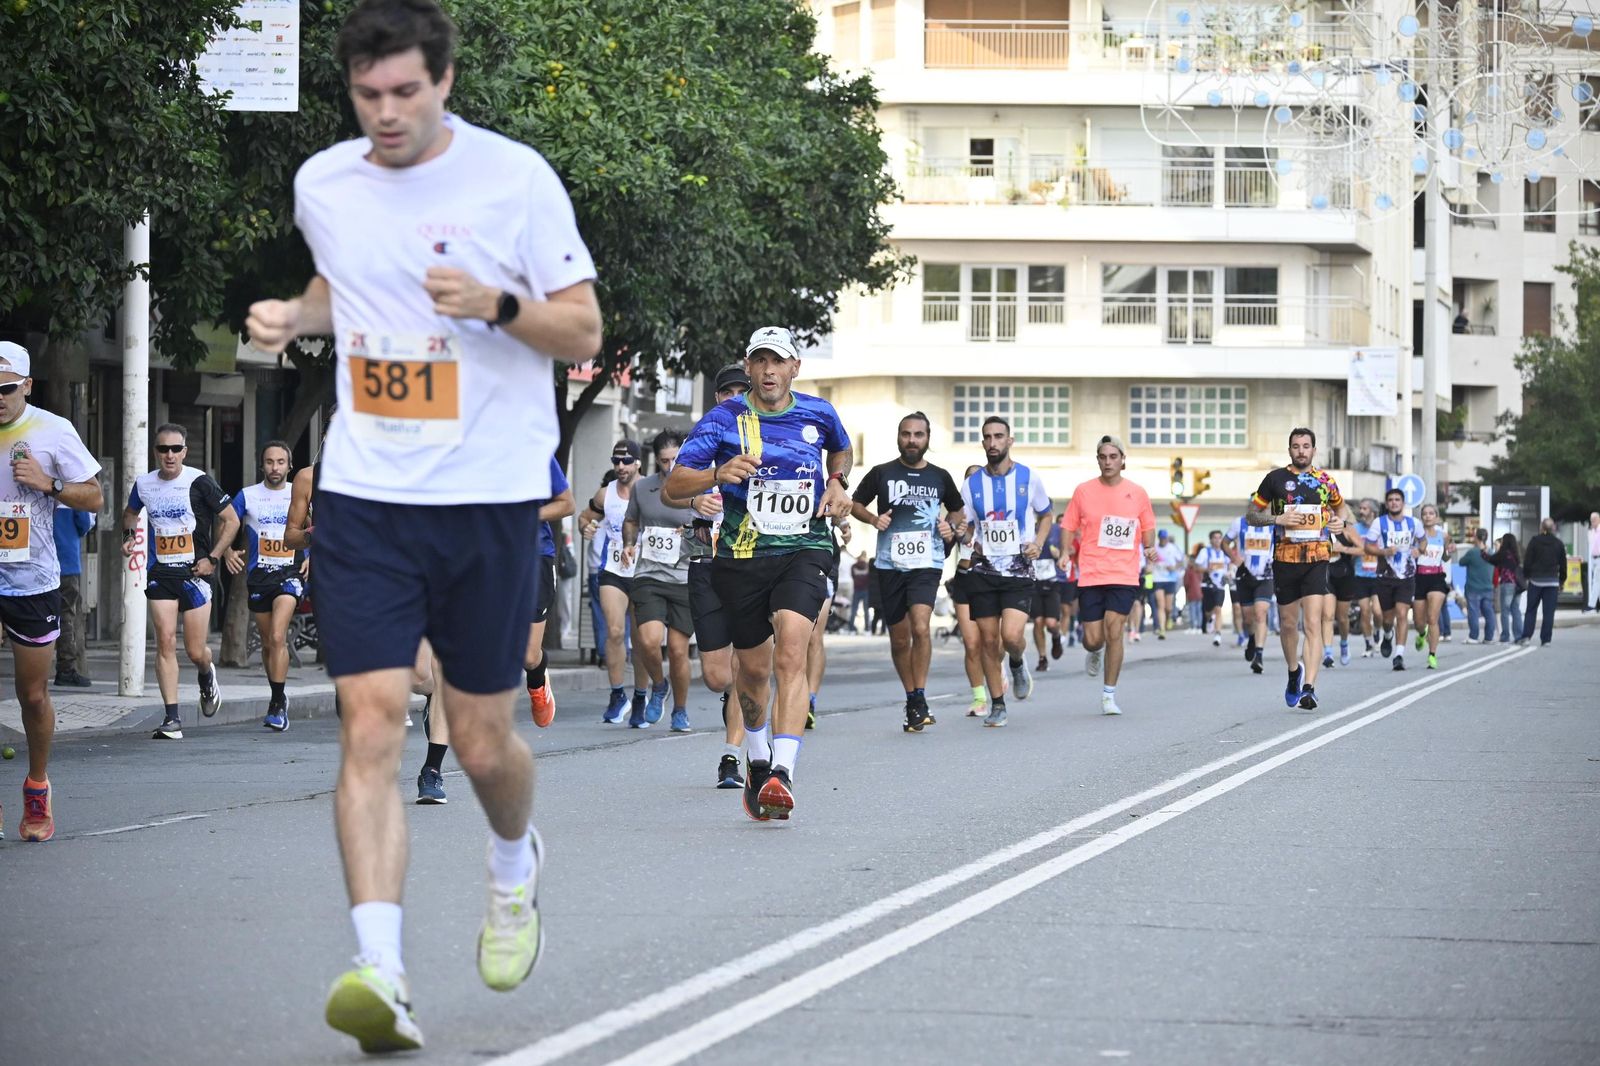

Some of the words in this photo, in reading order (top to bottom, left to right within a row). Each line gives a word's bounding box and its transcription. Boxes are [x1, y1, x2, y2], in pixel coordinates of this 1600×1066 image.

[364, 359, 433, 402] 581
[906, 485, 938, 498] HUELVA
[12, 504, 26, 514] 2K
[753, 491, 810, 515] 1100
[0, 518, 19, 541] 9
[763, 523, 791, 531] Huelva
[1106, 524, 1131, 538] 884
[160, 535, 187, 551] 370
[648, 535, 674, 551] 933
[984, 530, 1016, 543] 1001
[897, 541, 926, 556] 896
